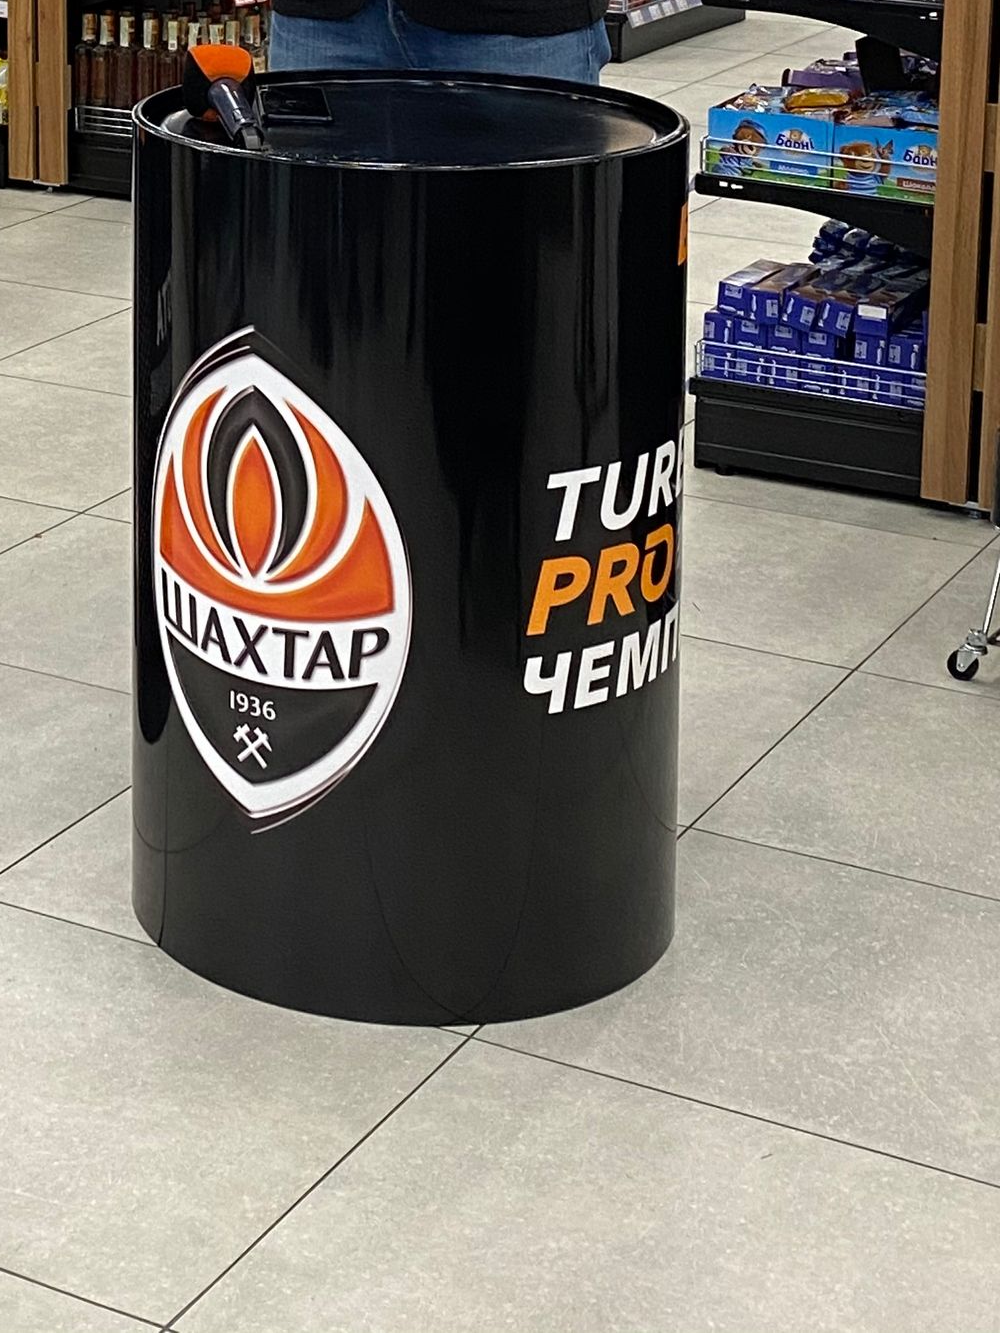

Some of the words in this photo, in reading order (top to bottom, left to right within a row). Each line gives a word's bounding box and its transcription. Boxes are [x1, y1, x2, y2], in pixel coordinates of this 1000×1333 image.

[902, 149, 939, 169] Барн
[546, 437, 684, 542] TUR
[160, 566, 390, 681] ШАХТАР
[525, 522, 676, 637] PRO
[229, 689, 276, 721] 1936
[522, 604, 679, 715] ЧЕМП
